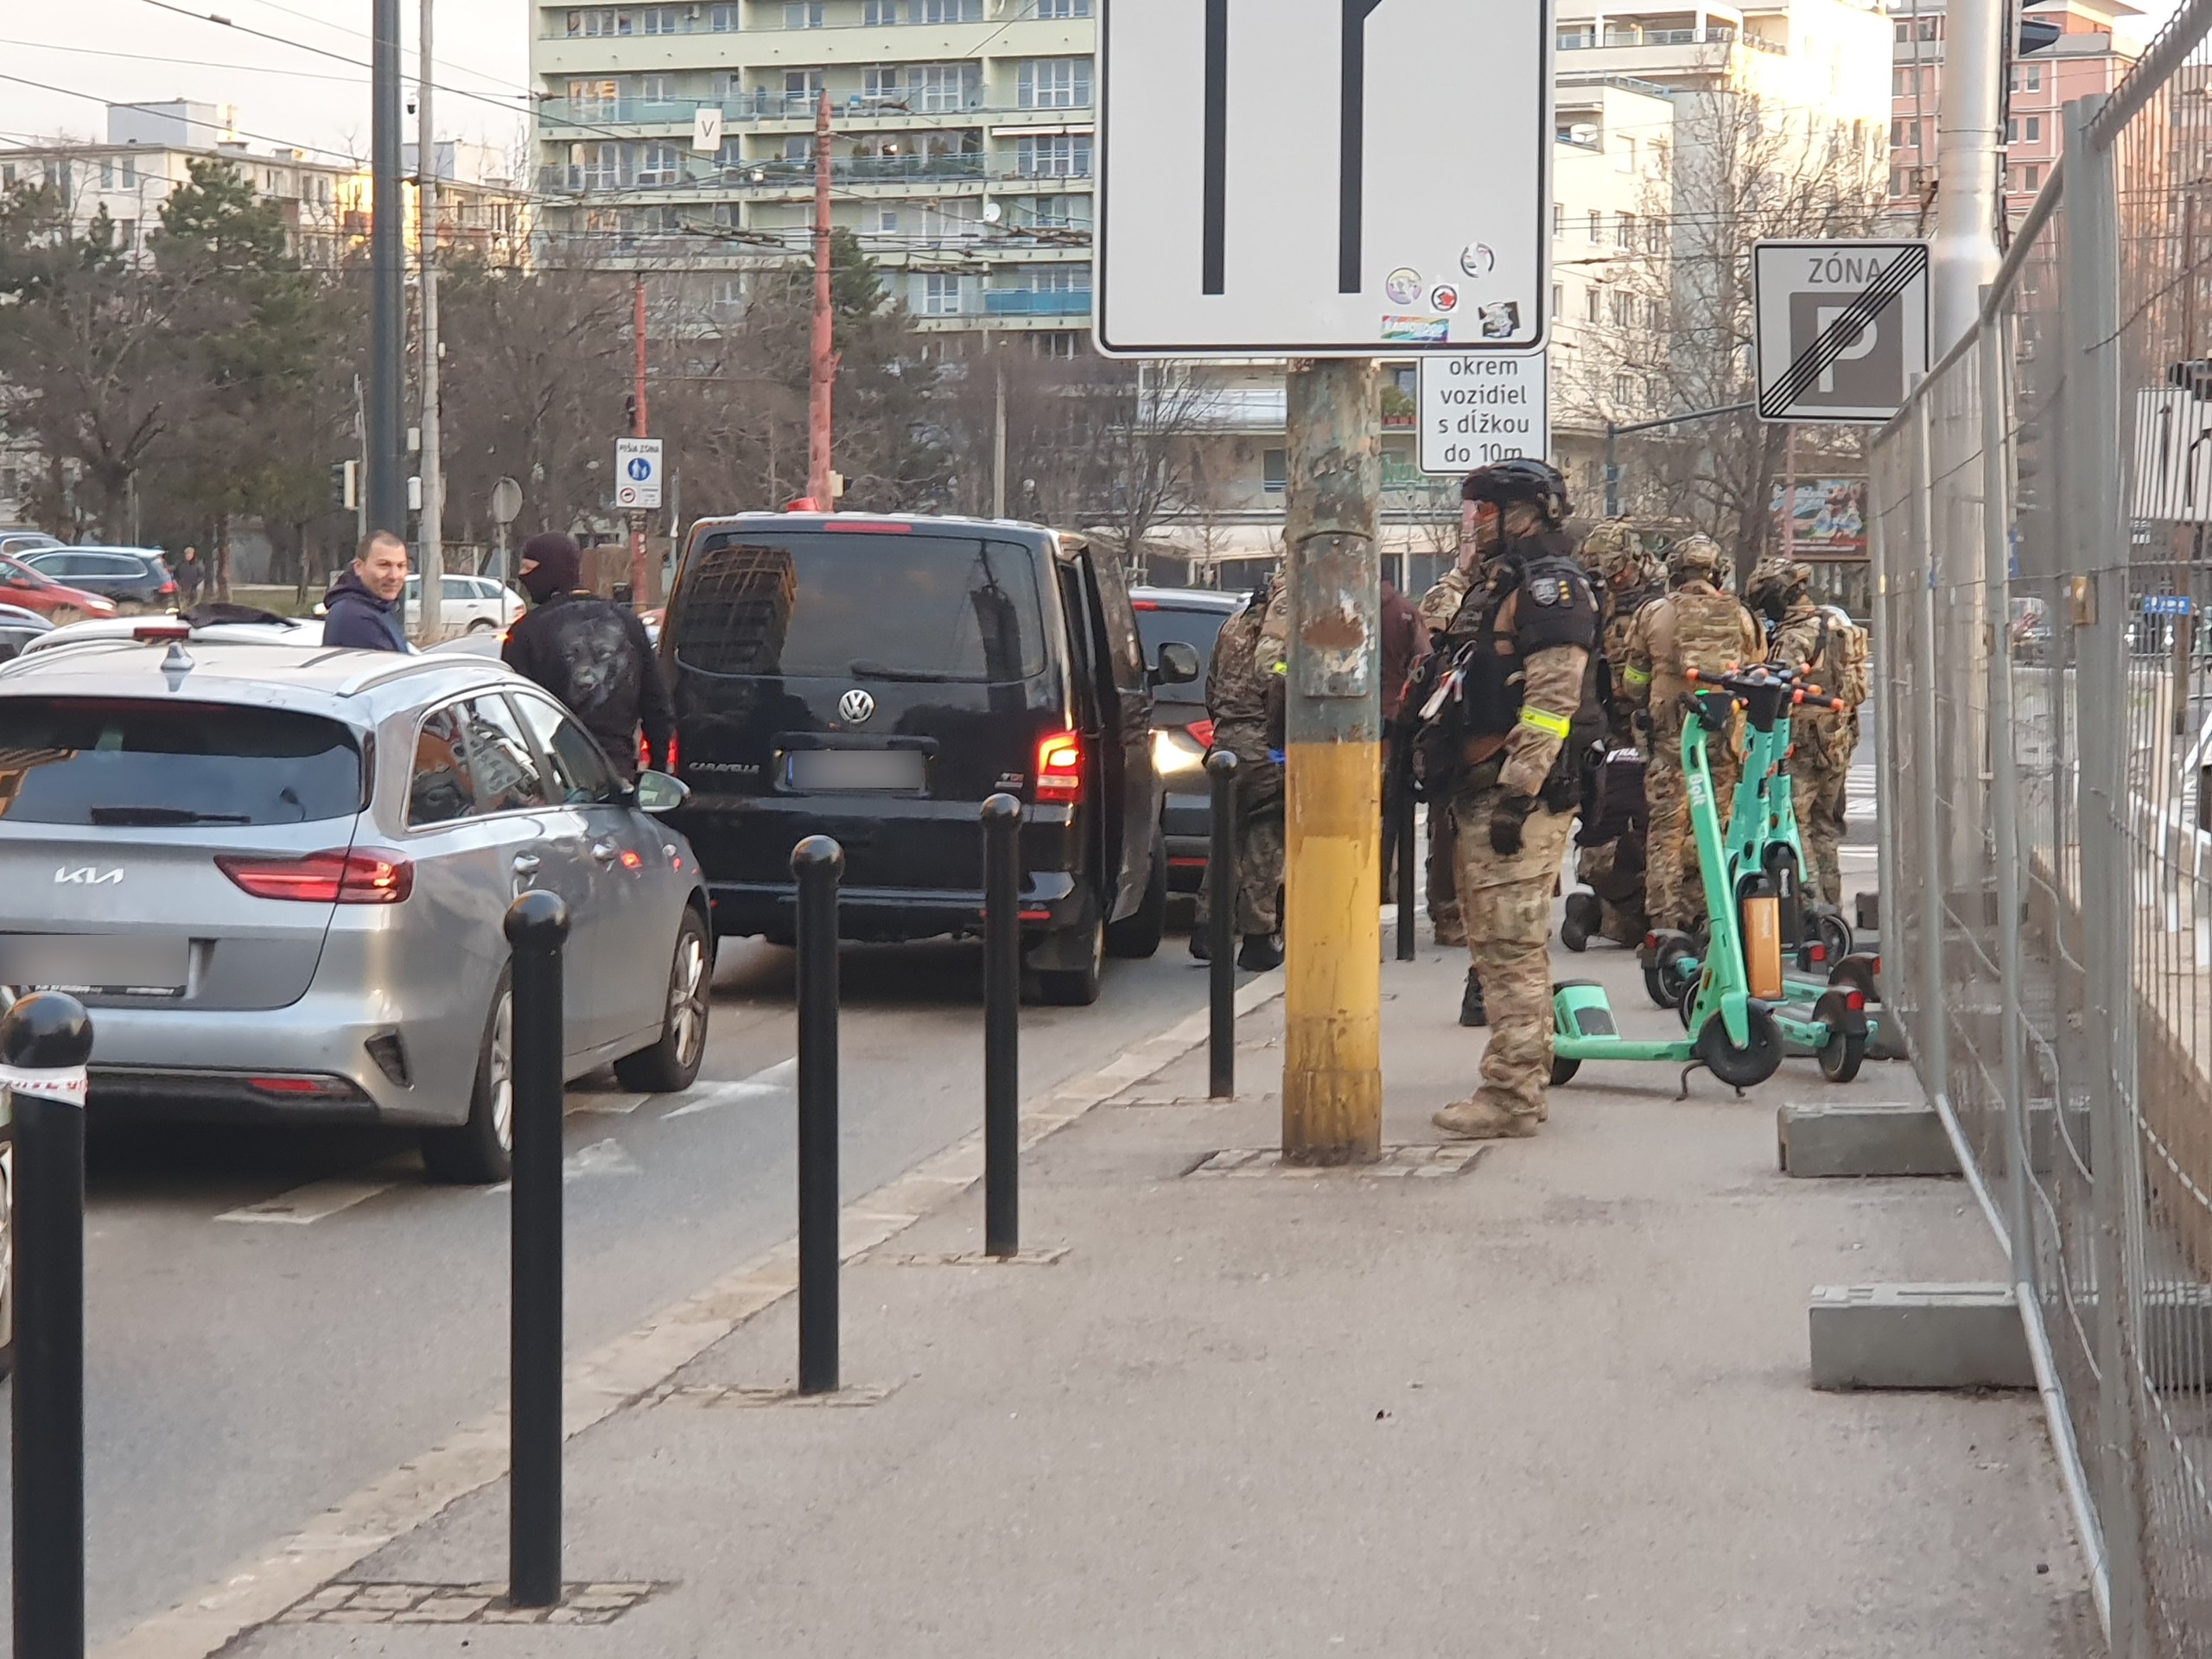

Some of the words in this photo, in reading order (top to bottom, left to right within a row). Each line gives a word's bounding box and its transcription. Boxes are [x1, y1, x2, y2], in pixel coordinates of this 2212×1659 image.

[701, 120, 715, 137] V
[1808, 251, 1883, 283] ZÓNA
[1817, 306, 1878, 392] P
[1449, 357, 1518, 376] okrem
[1440, 384, 1528, 404] vozidiel
[1438, 418, 1449, 433] s
[1457, 409, 1529, 433] dĺžkou
[1444, 443, 1471, 462] do
[1479, 442, 1522, 462] 10m
[1688, 773, 1707, 807] Bolt
